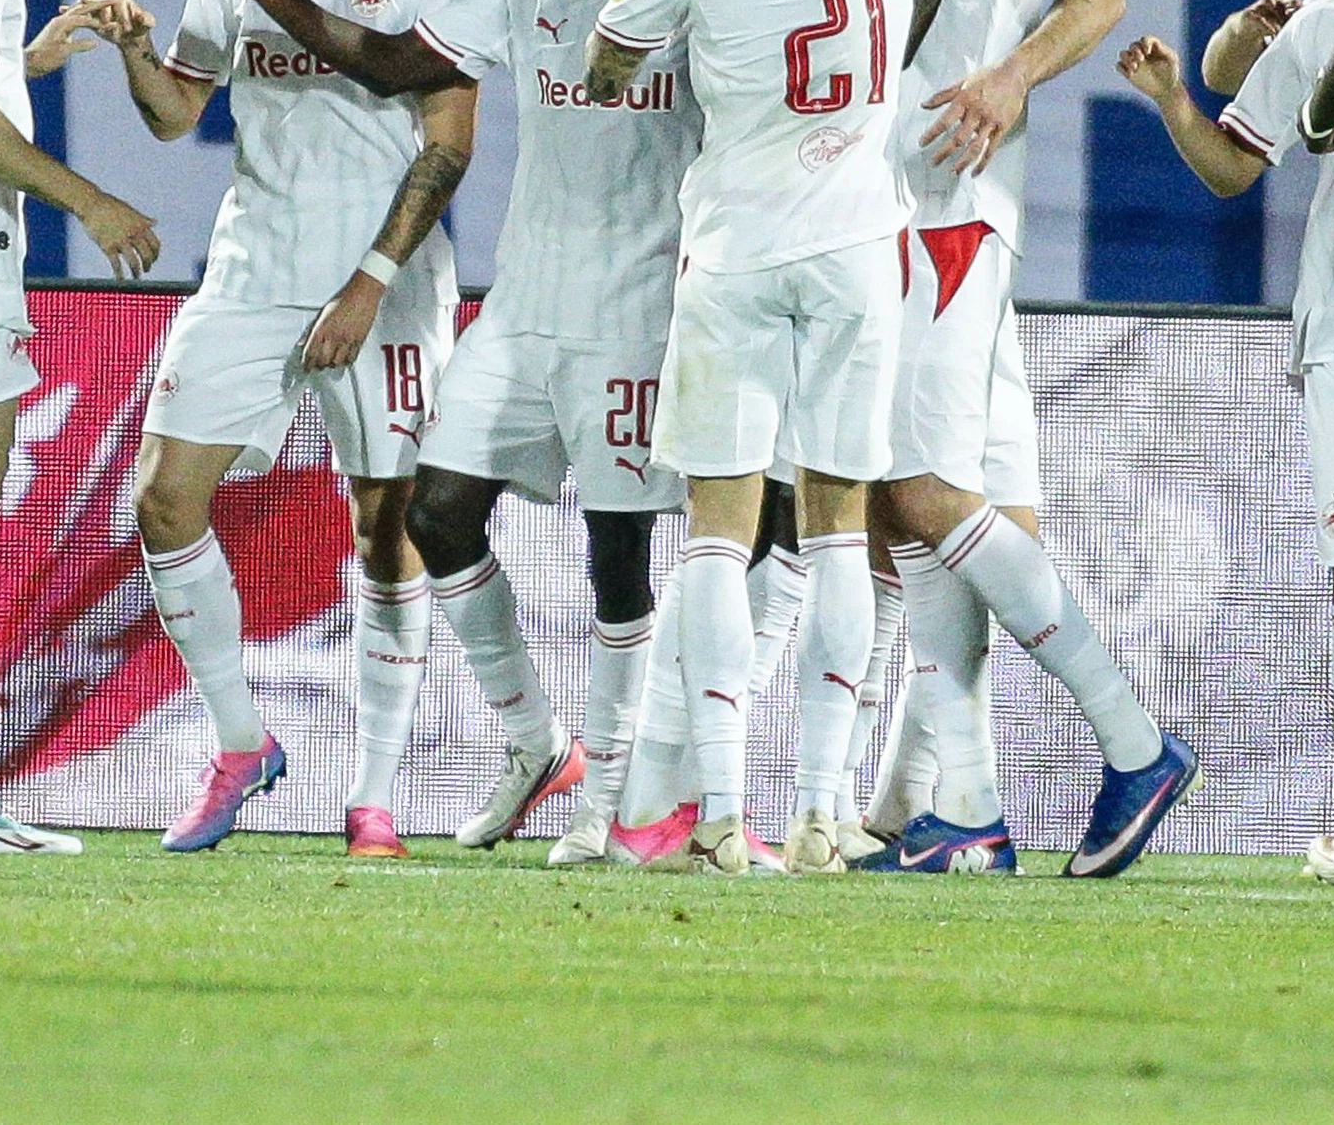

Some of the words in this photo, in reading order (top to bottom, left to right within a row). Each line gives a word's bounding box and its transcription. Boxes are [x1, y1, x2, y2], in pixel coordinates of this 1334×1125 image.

[601, 71, 675, 111] ull
[380, 343, 424, 412] 18
[605, 378, 660, 448] 20
